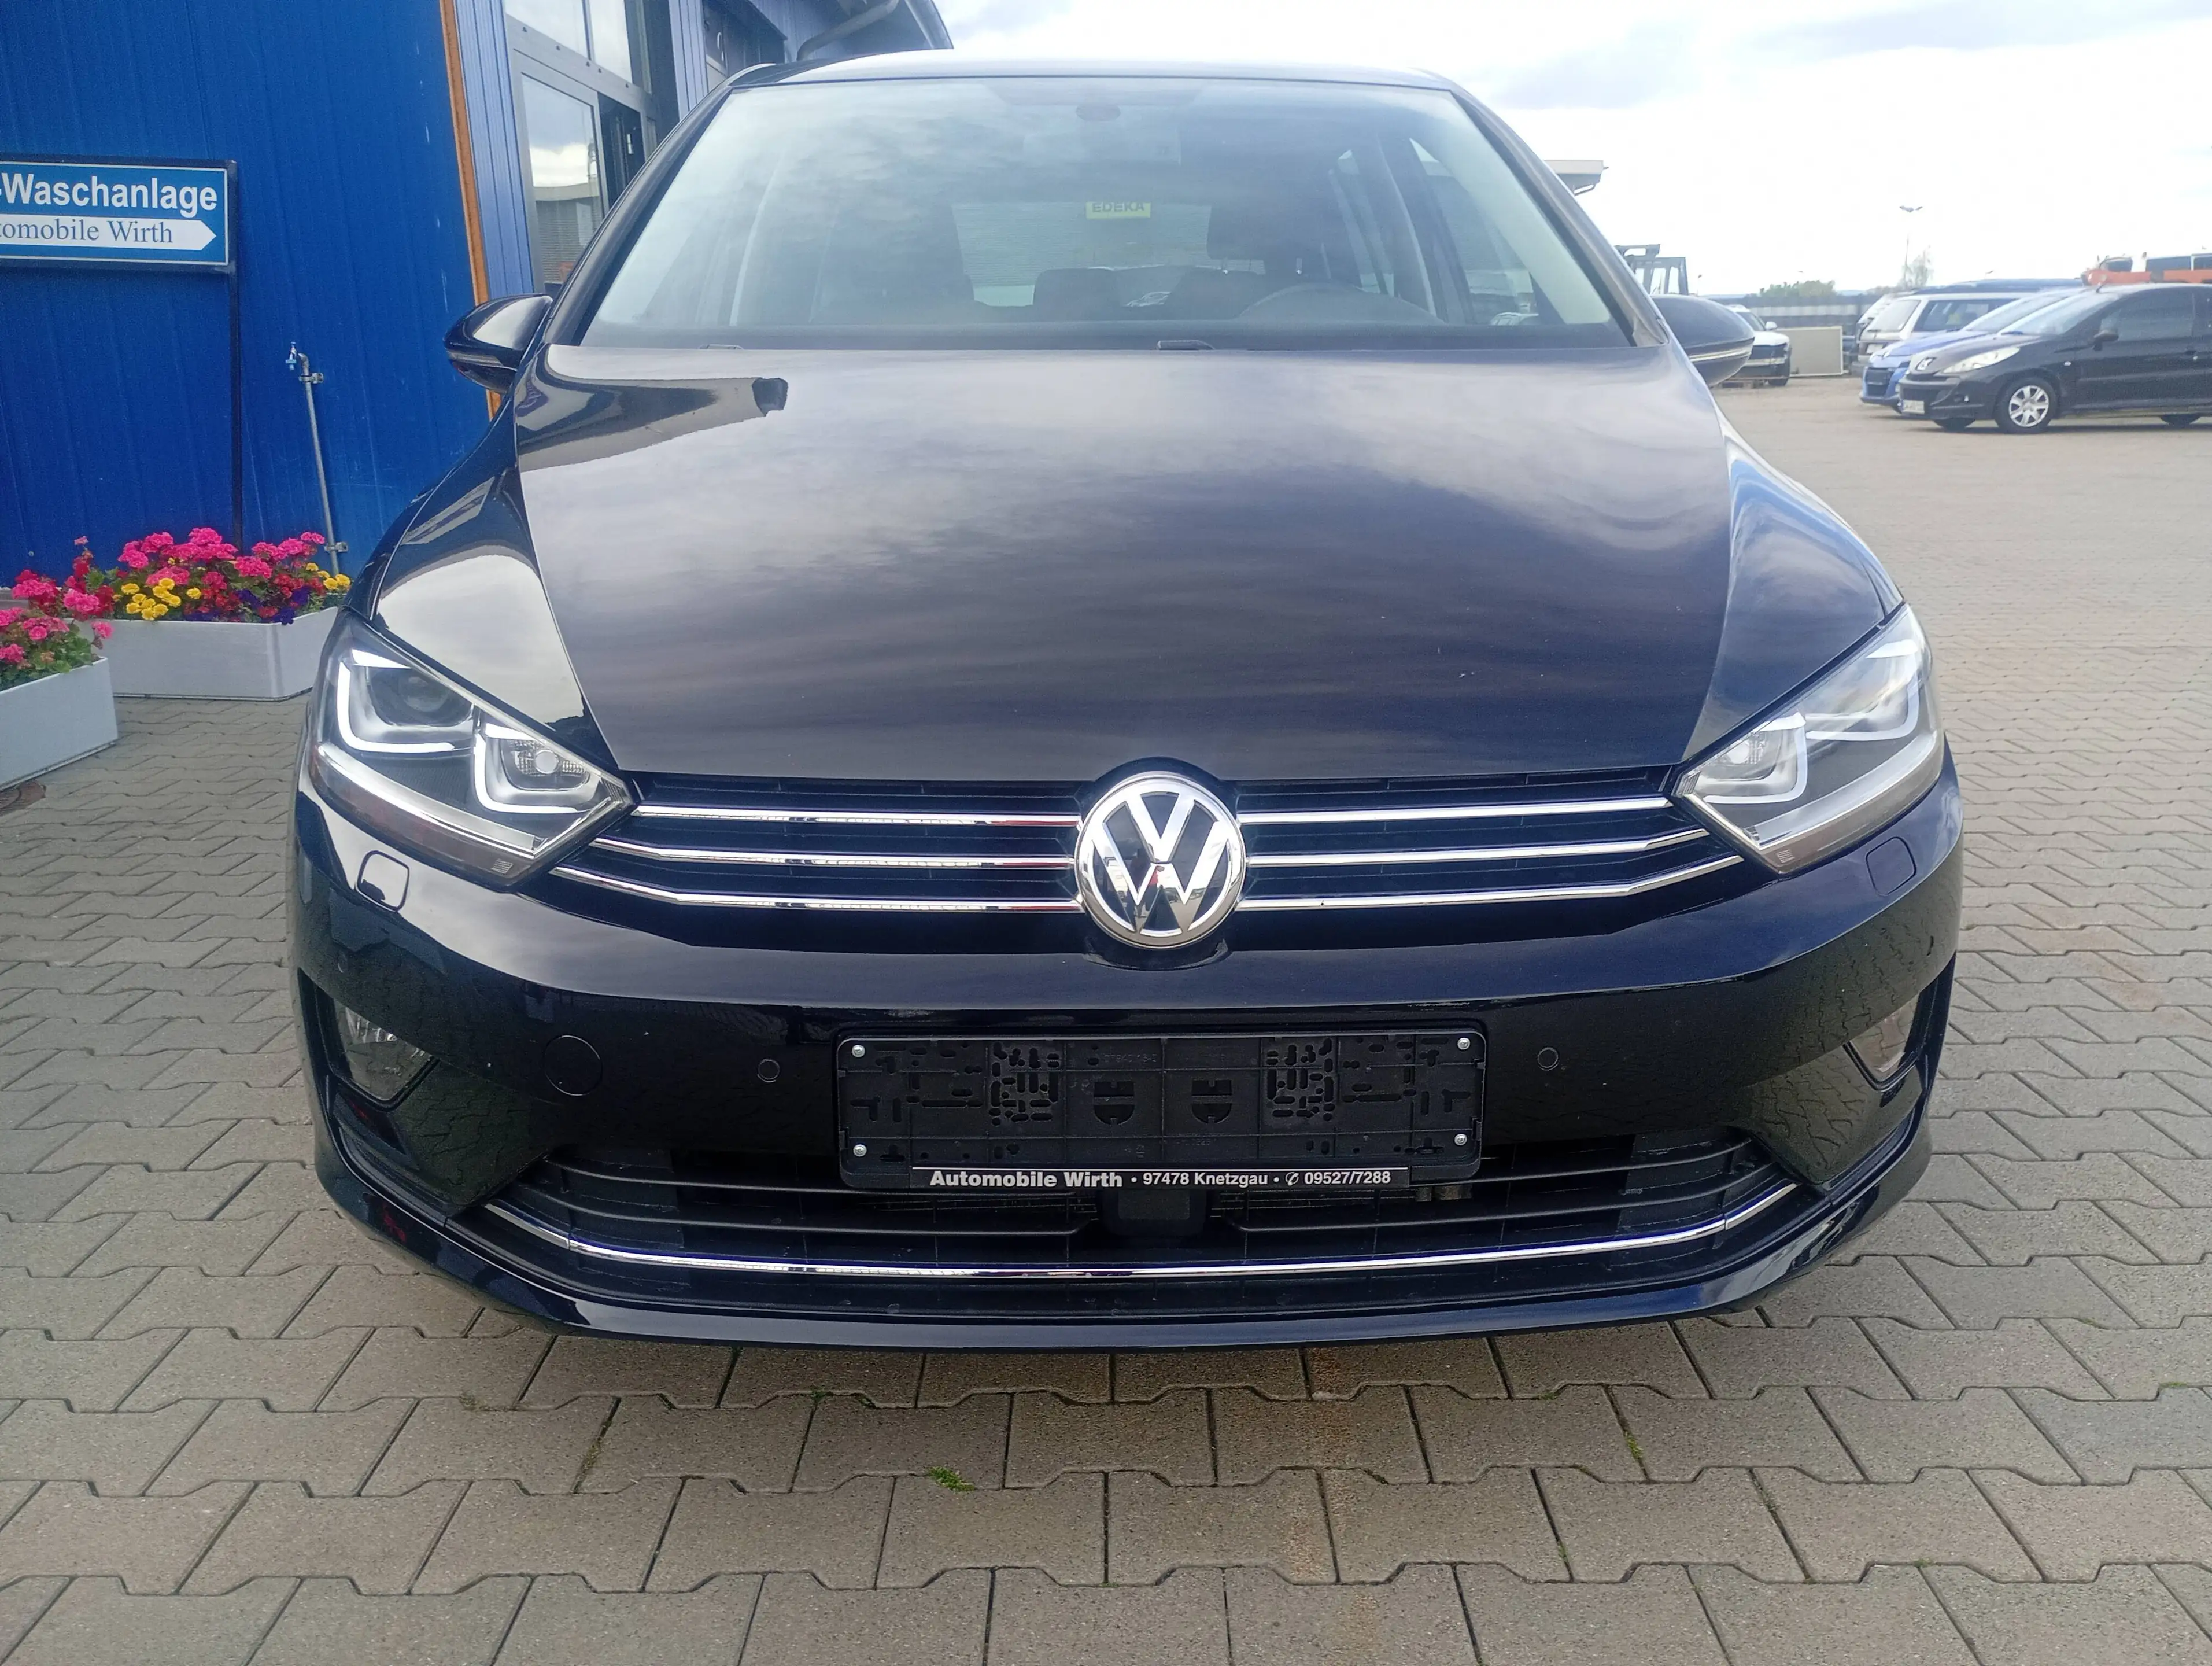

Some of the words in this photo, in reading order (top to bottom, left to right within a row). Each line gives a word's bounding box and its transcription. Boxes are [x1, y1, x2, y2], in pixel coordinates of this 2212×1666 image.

[0, 172, 217, 218] Waschanlage
[1092, 202, 1145, 212] EDEKA
[0, 219, 99, 241] omobile
[108, 220, 173, 244] Wirth
[1083, 784, 1239, 940] VW
[929, 1170, 1058, 1188] Automobile
[1063, 1171, 1123, 1188] Wirth
[1143, 1172, 1190, 1185] 97478
[1194, 1172, 1268, 1188] Knetzgau
[1304, 1171, 1391, 1185] 09527/7288
